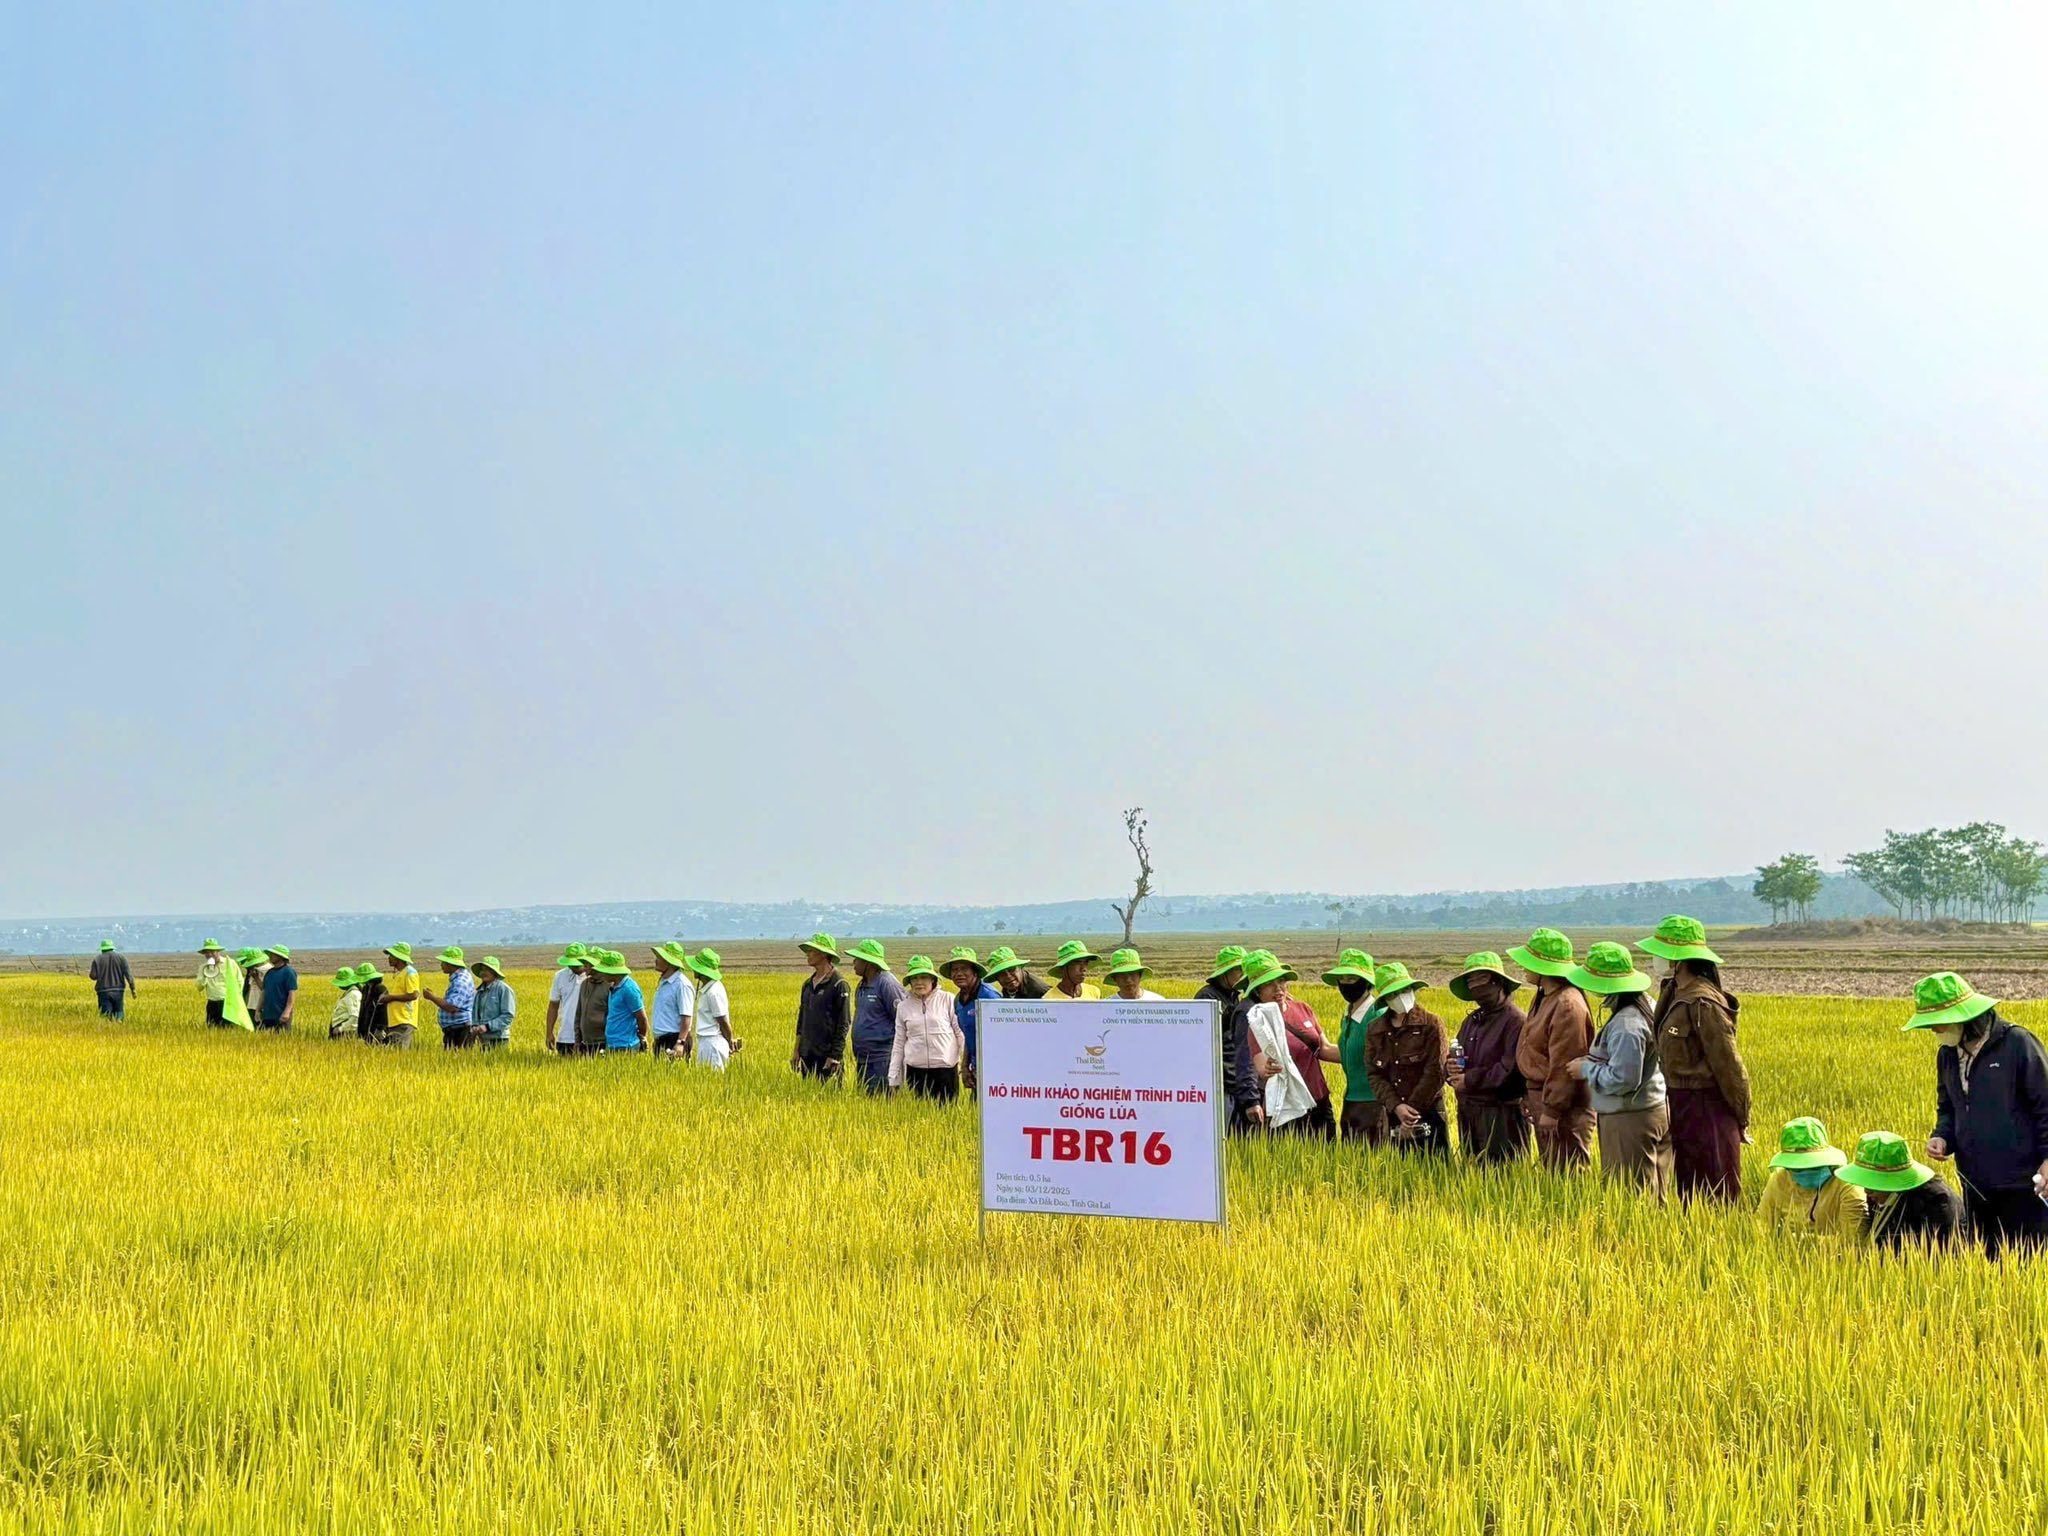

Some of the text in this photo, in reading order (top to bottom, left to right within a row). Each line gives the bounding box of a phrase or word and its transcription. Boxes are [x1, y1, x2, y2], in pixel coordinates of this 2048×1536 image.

[988, 1083, 1207, 1104] MÔ HÌNH KHẢO NGHIỆM TRÌNH DIỄN
[1060, 1102, 1138, 1120] GIỐNG LÚA
[1022, 1126, 1172, 1166] TBR16
[1042, 1174, 1051, 1182] ha
[1025, 1185, 1071, 1195] 03/12/2025
[1086, 1200, 1099, 1208] Gia
[1100, 1201, 1111, 1209] Lai
